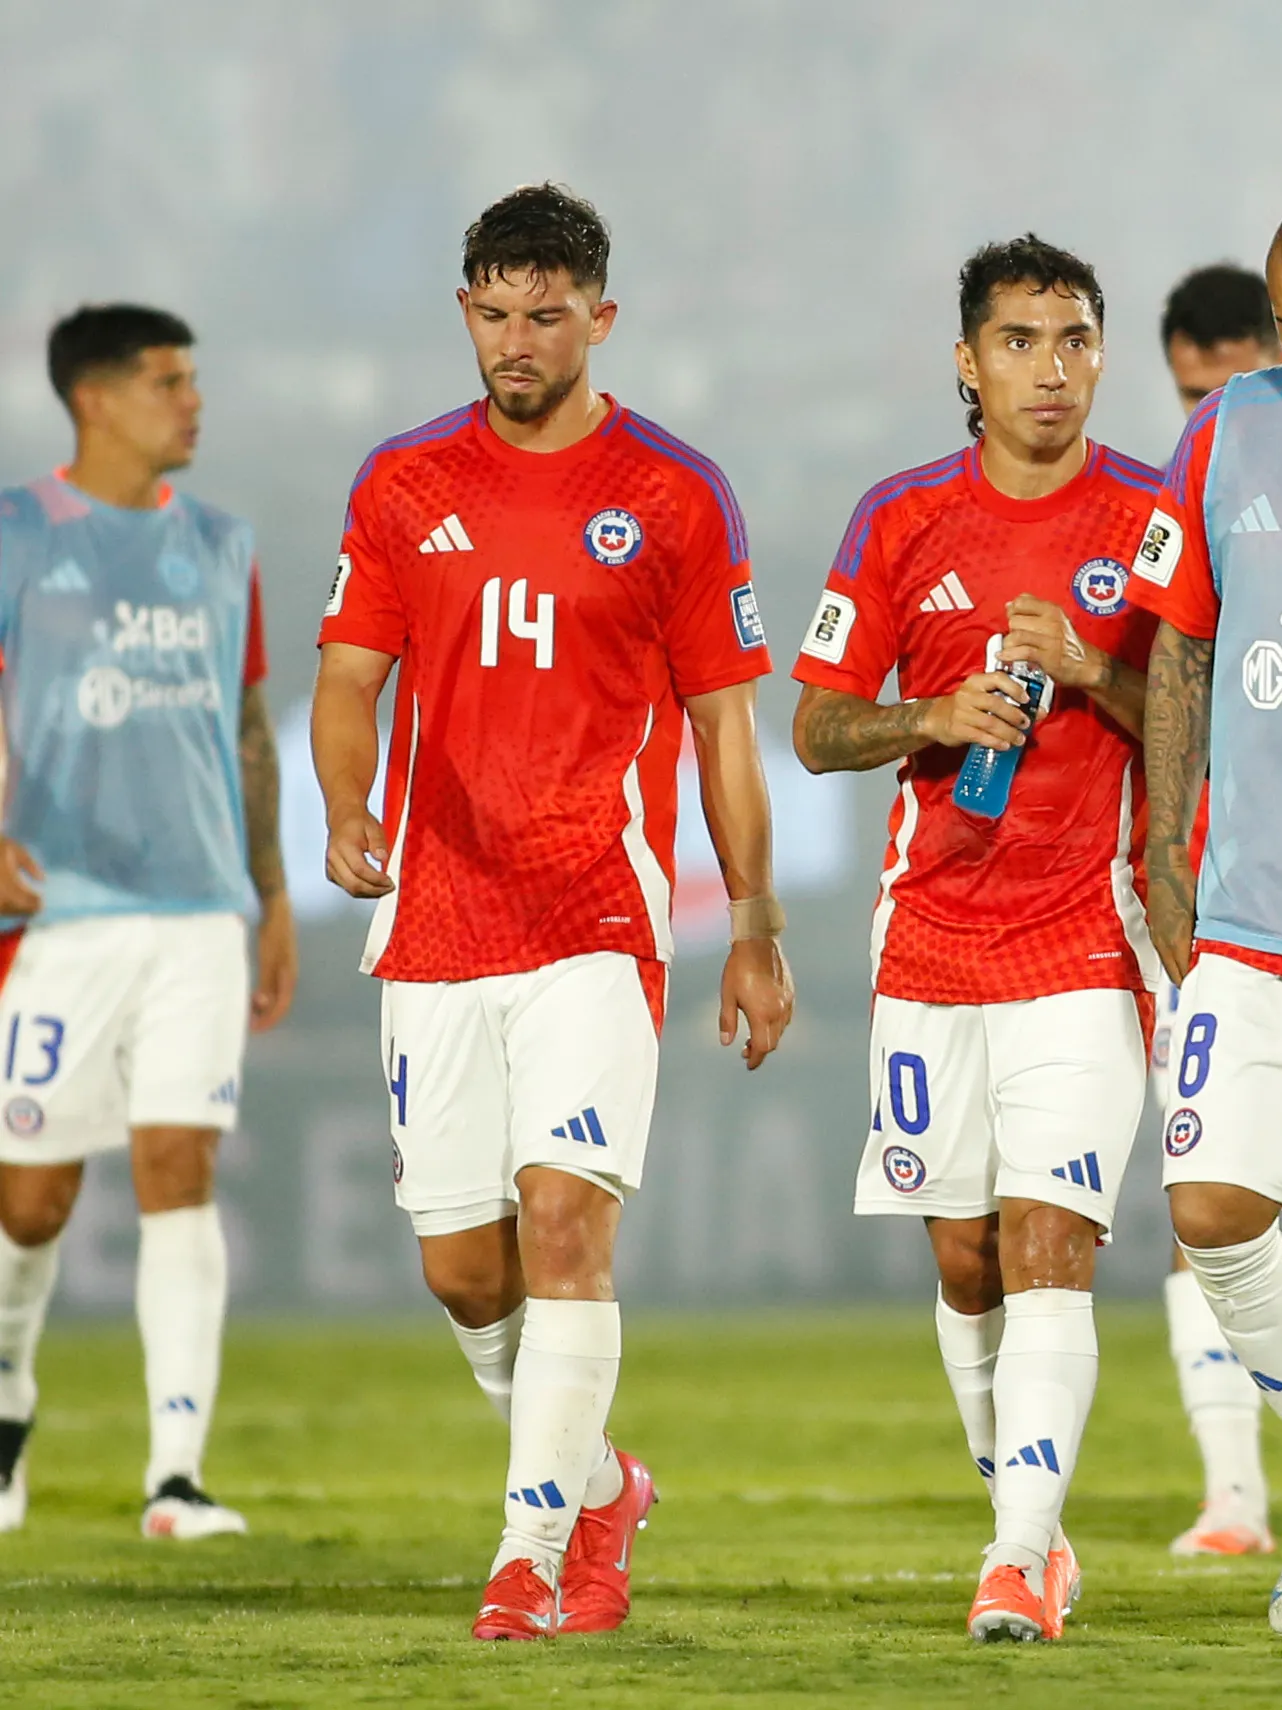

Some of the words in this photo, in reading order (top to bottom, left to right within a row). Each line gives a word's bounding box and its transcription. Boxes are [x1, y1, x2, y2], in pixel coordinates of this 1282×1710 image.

[480, 575, 555, 669] 14
[6, 1012, 65, 1086] 13
[1178, 1012, 1218, 1099] 8
